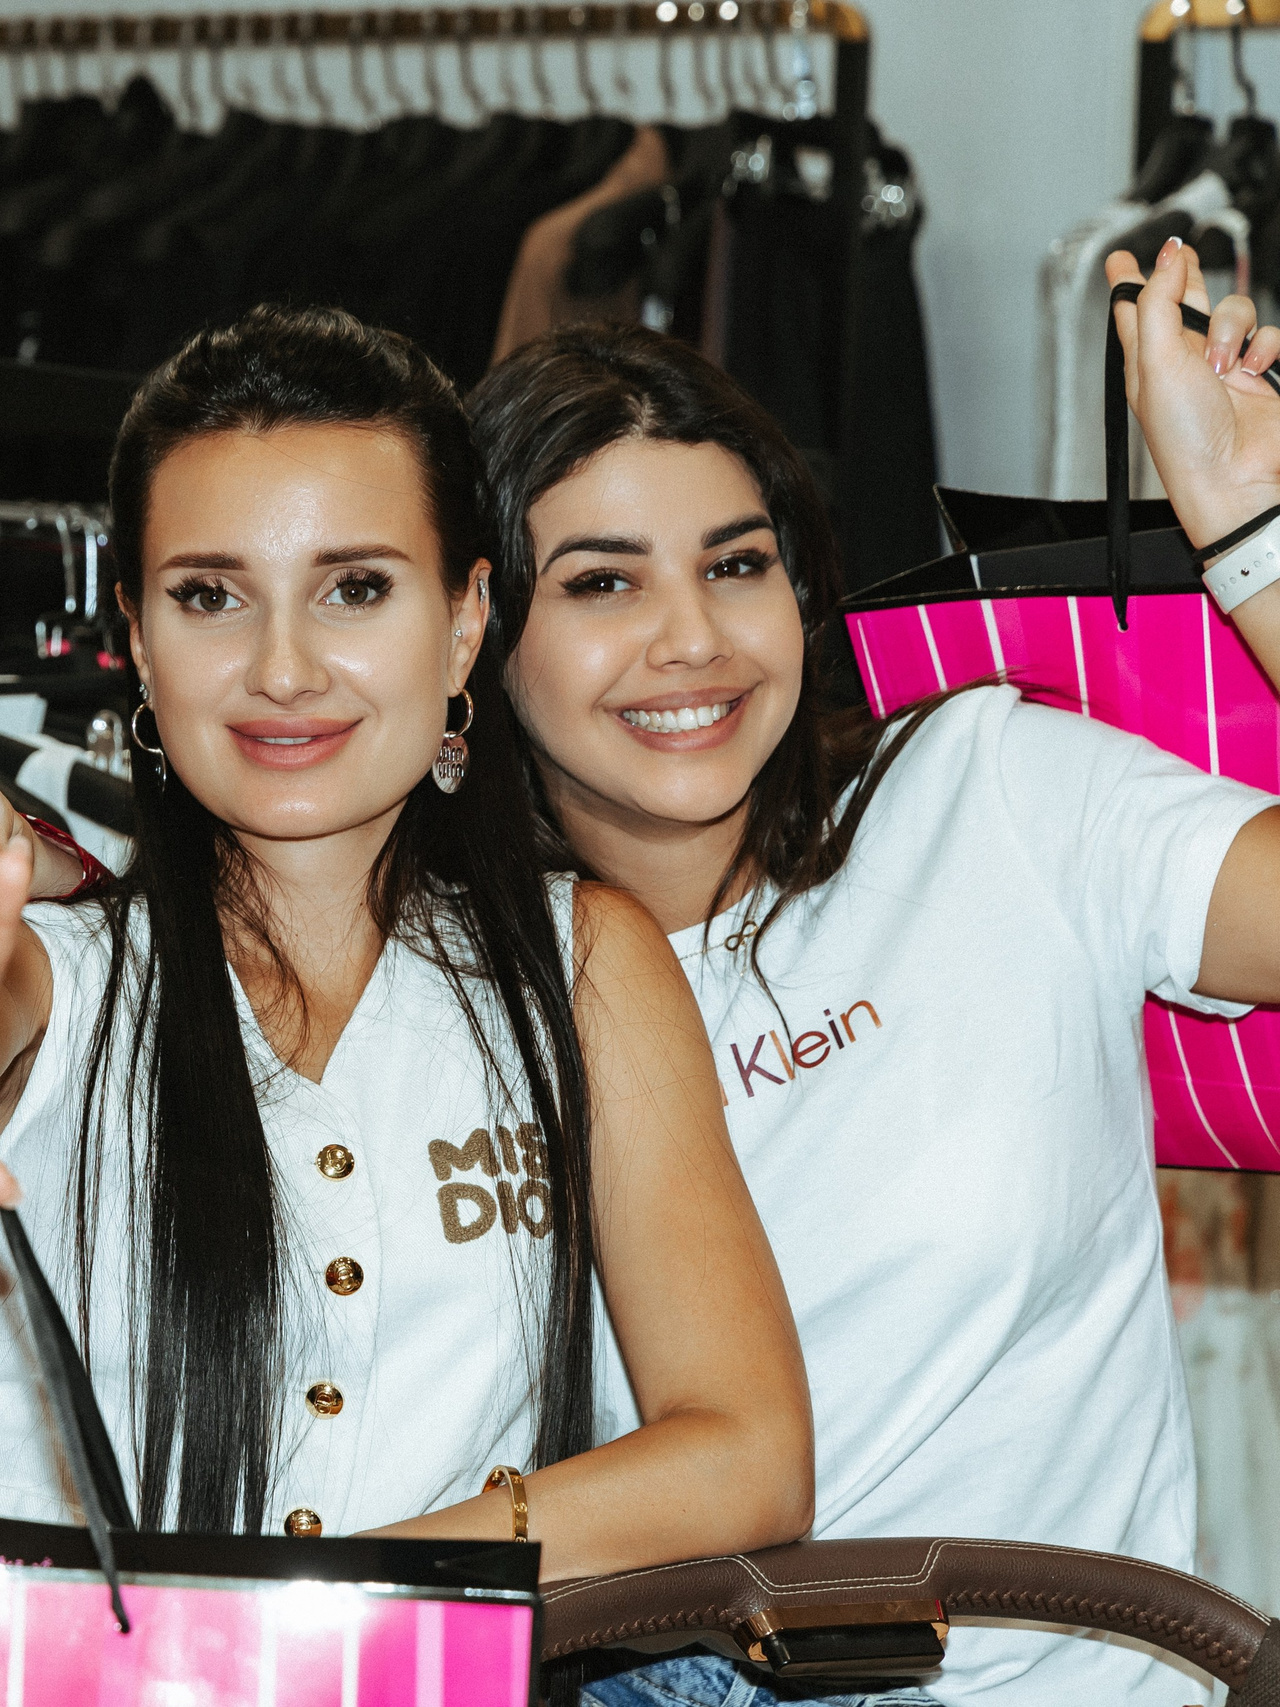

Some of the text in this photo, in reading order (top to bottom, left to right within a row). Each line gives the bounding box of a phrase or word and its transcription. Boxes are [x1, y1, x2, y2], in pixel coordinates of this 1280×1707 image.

[729, 1000, 883, 1098] Klein
[428, 1122, 552, 1182] MIS
[436, 1181, 554, 1244] DIO
